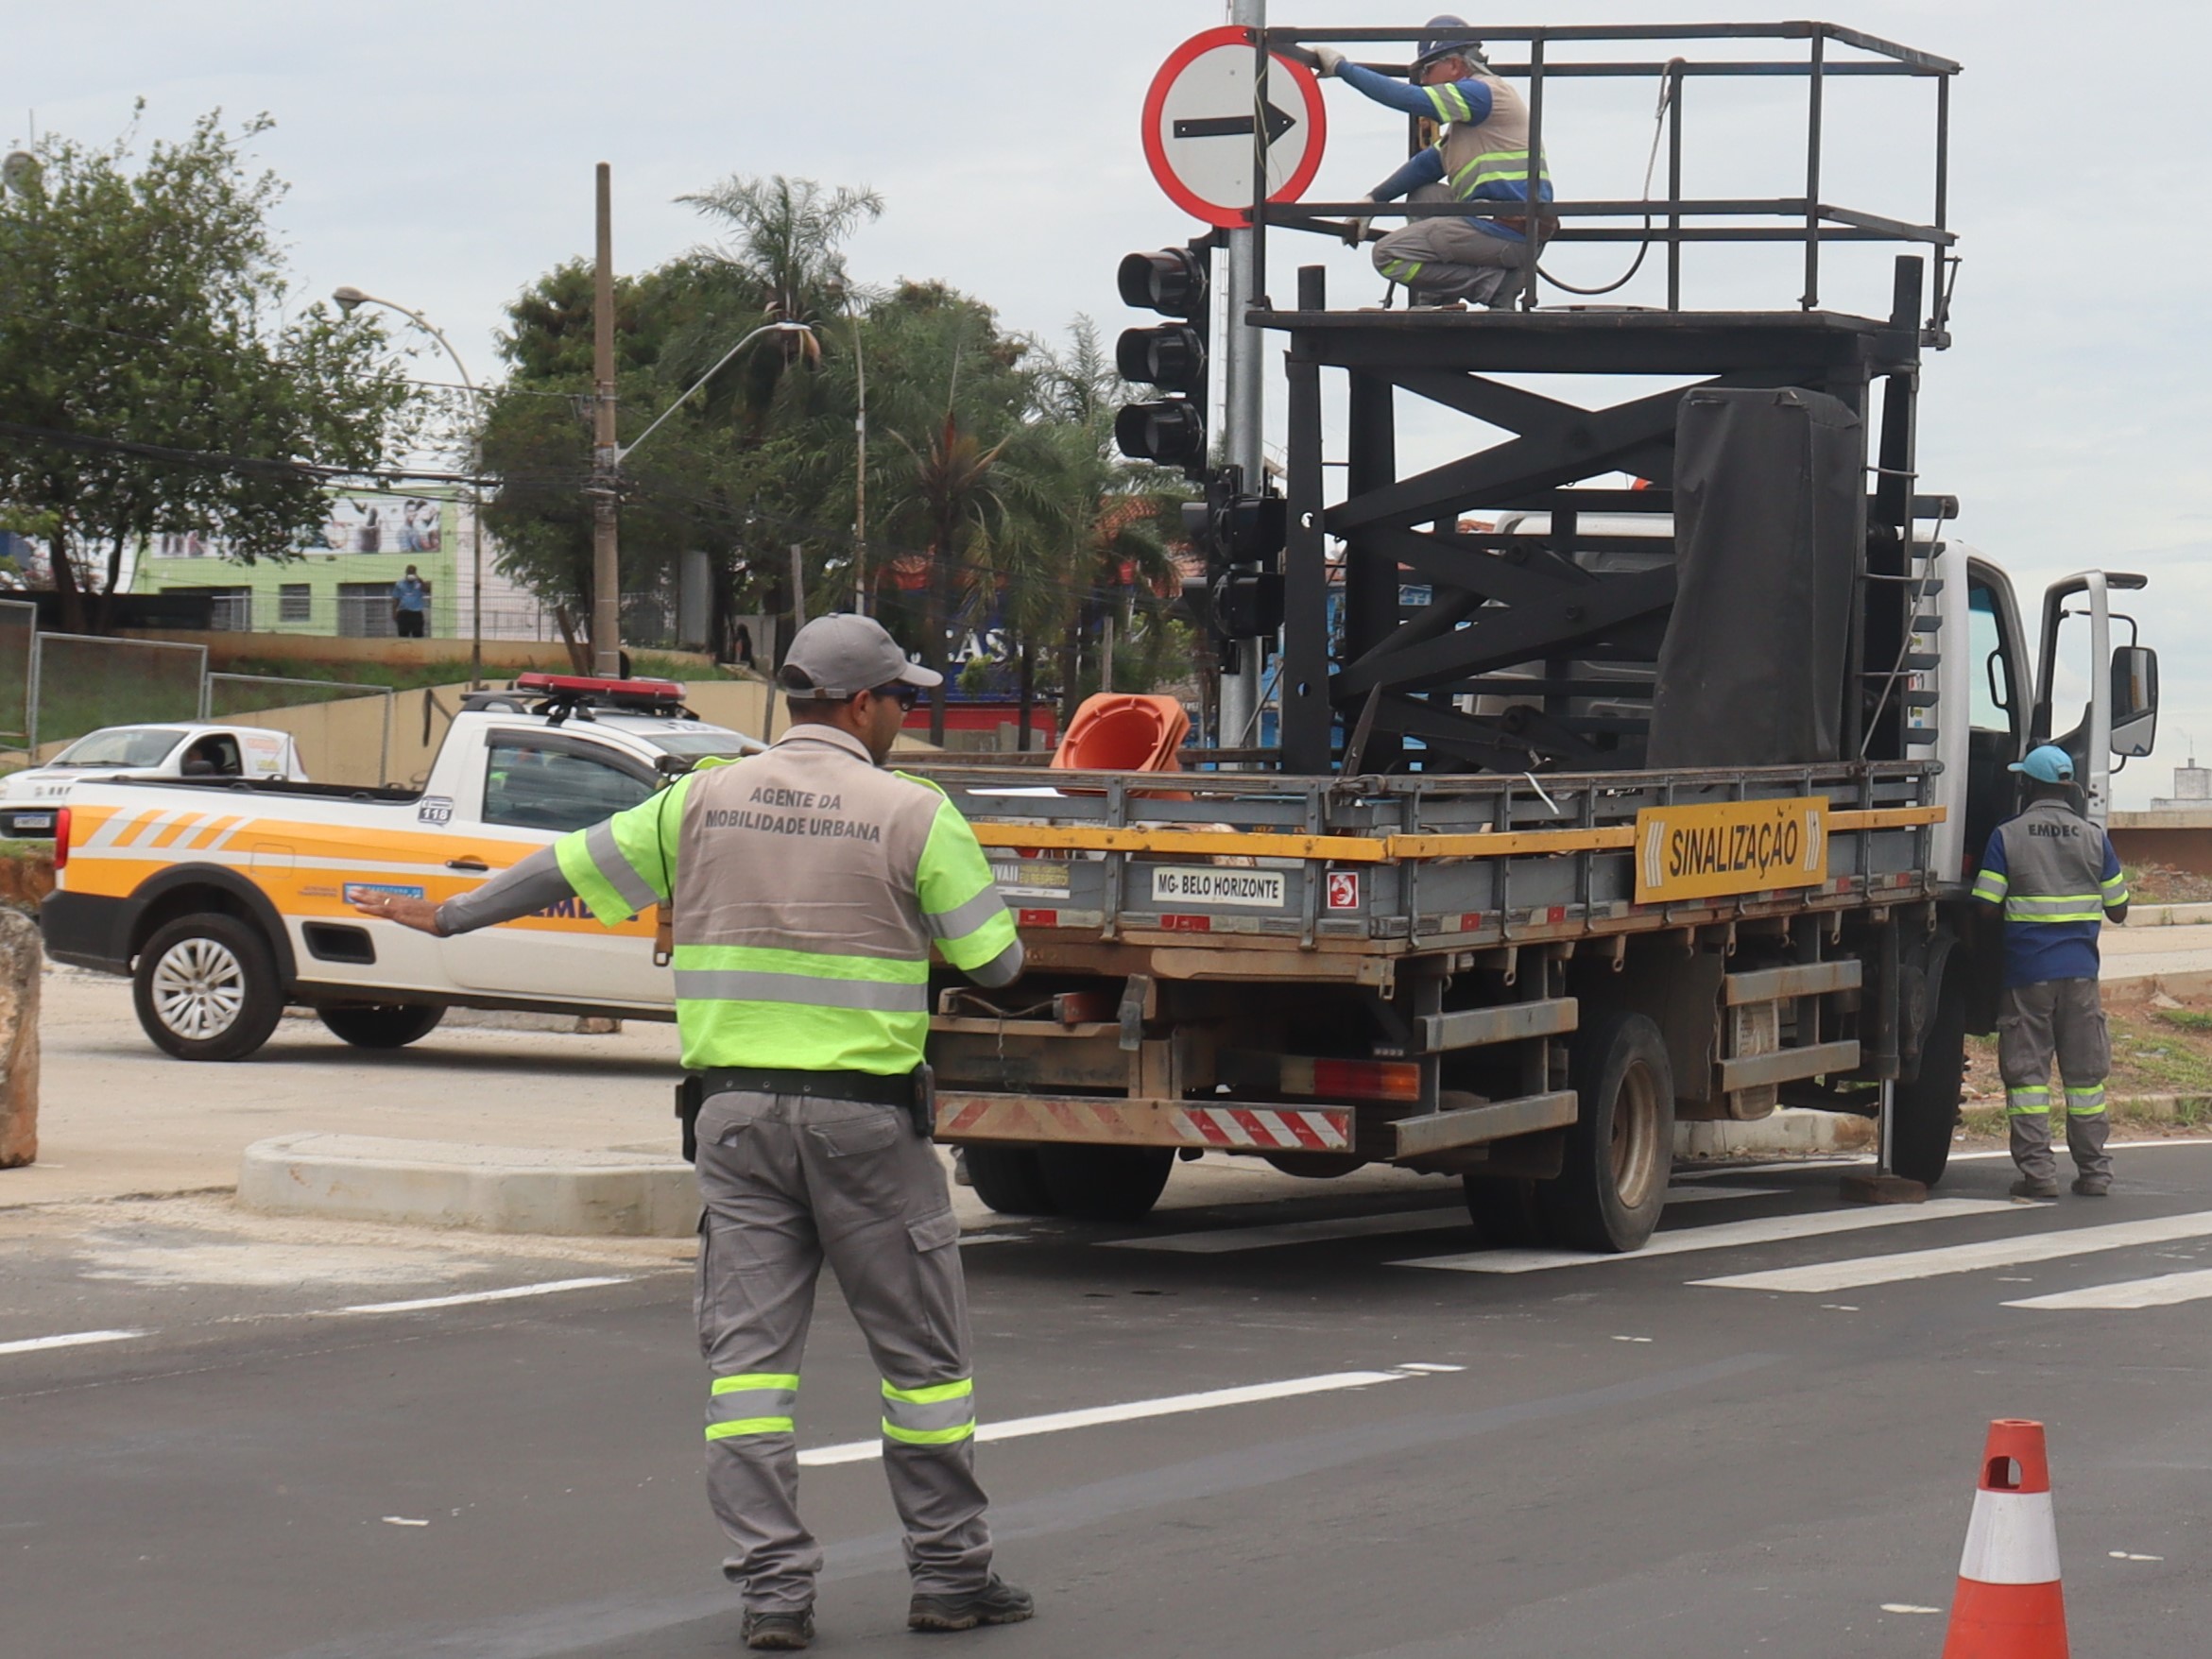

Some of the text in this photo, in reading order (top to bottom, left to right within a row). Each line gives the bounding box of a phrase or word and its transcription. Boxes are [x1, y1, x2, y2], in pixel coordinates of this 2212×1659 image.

[749, 787, 841, 811] AGENTE DA
[423, 808, 449, 820] 118
[705, 810, 880, 843] MOBILIDADE URBANA
[2028, 824, 2080, 837] EMDEC
[1182, 875, 1210, 896] BELO
[1214, 877, 1278, 898] HORIZONTE
